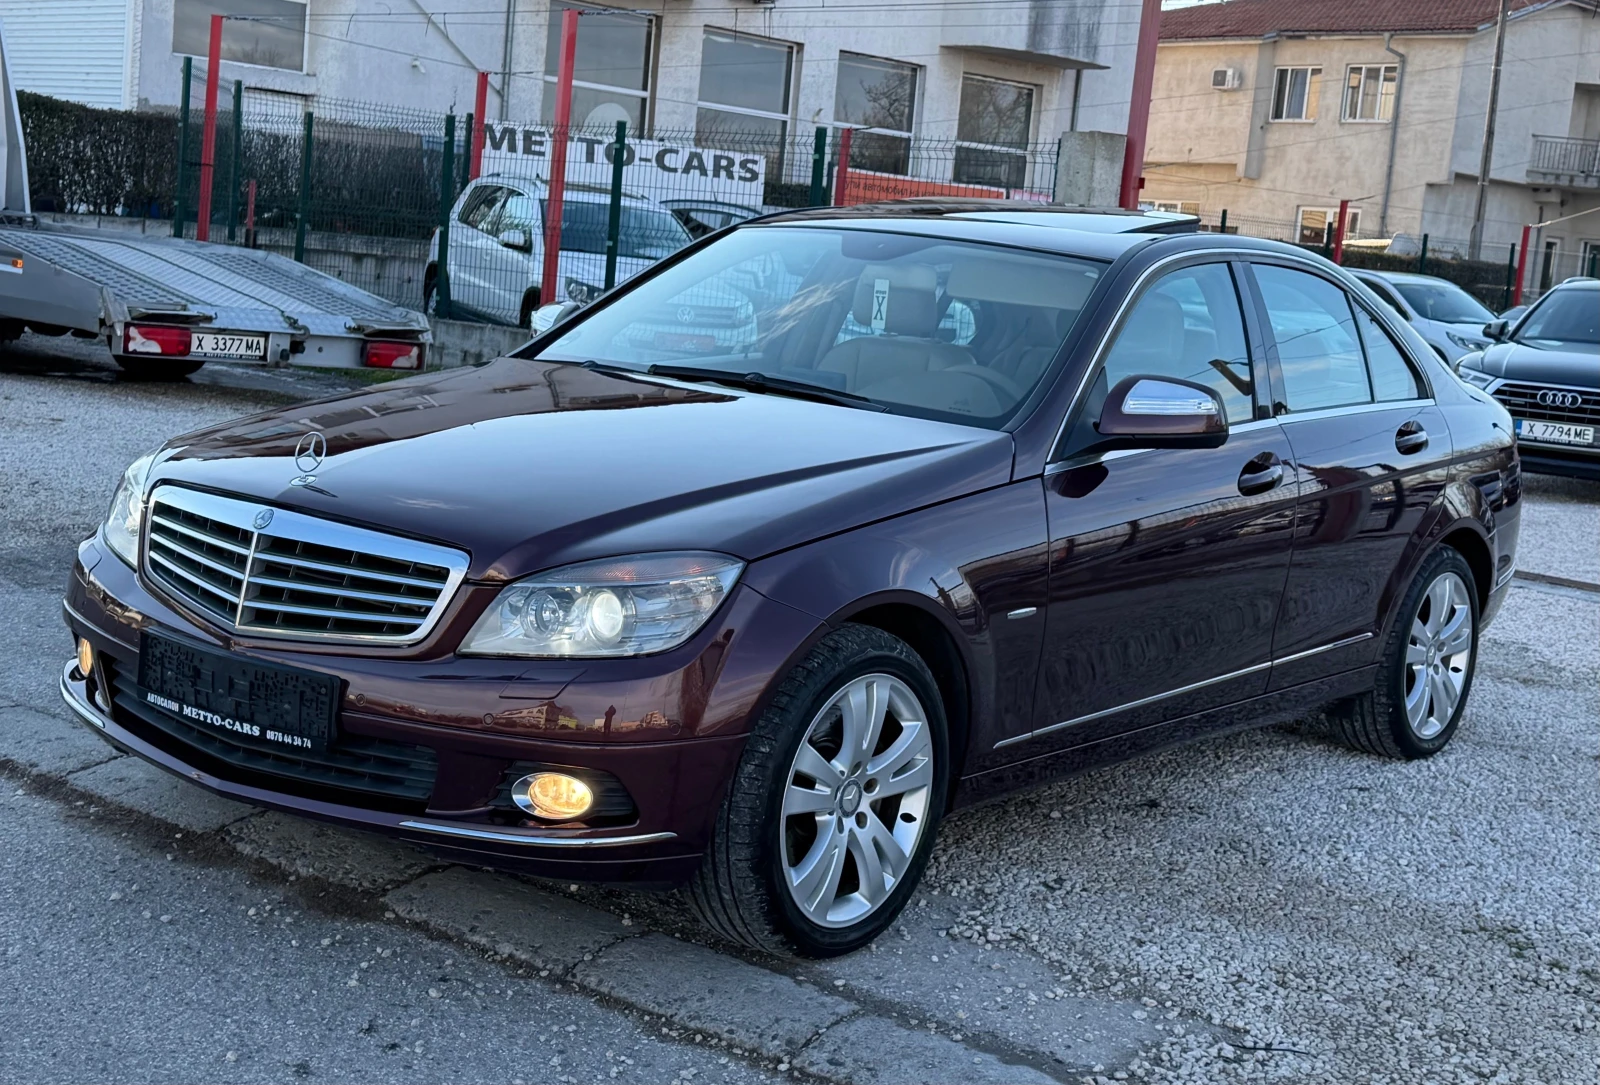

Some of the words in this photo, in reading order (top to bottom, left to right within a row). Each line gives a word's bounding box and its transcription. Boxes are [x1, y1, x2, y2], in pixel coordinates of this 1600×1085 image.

[483, 123, 759, 182] METO-CARS
[195, 335, 205, 351] X
[211, 336, 243, 352] 3377
[245, 338, 262, 354] MA
[1527, 422, 1536, 435] X
[1541, 424, 1572, 439] 7794
[1574, 427, 1591, 441] ME
[147, 692, 179, 712] АВТОСАЛОН
[182, 704, 260, 736] METTO-CARS
[266, 729, 283, 742] 0876
[283, 733, 292, 745] 44
[293, 735, 302, 747] 34
[303, 737, 312, 749] 74
